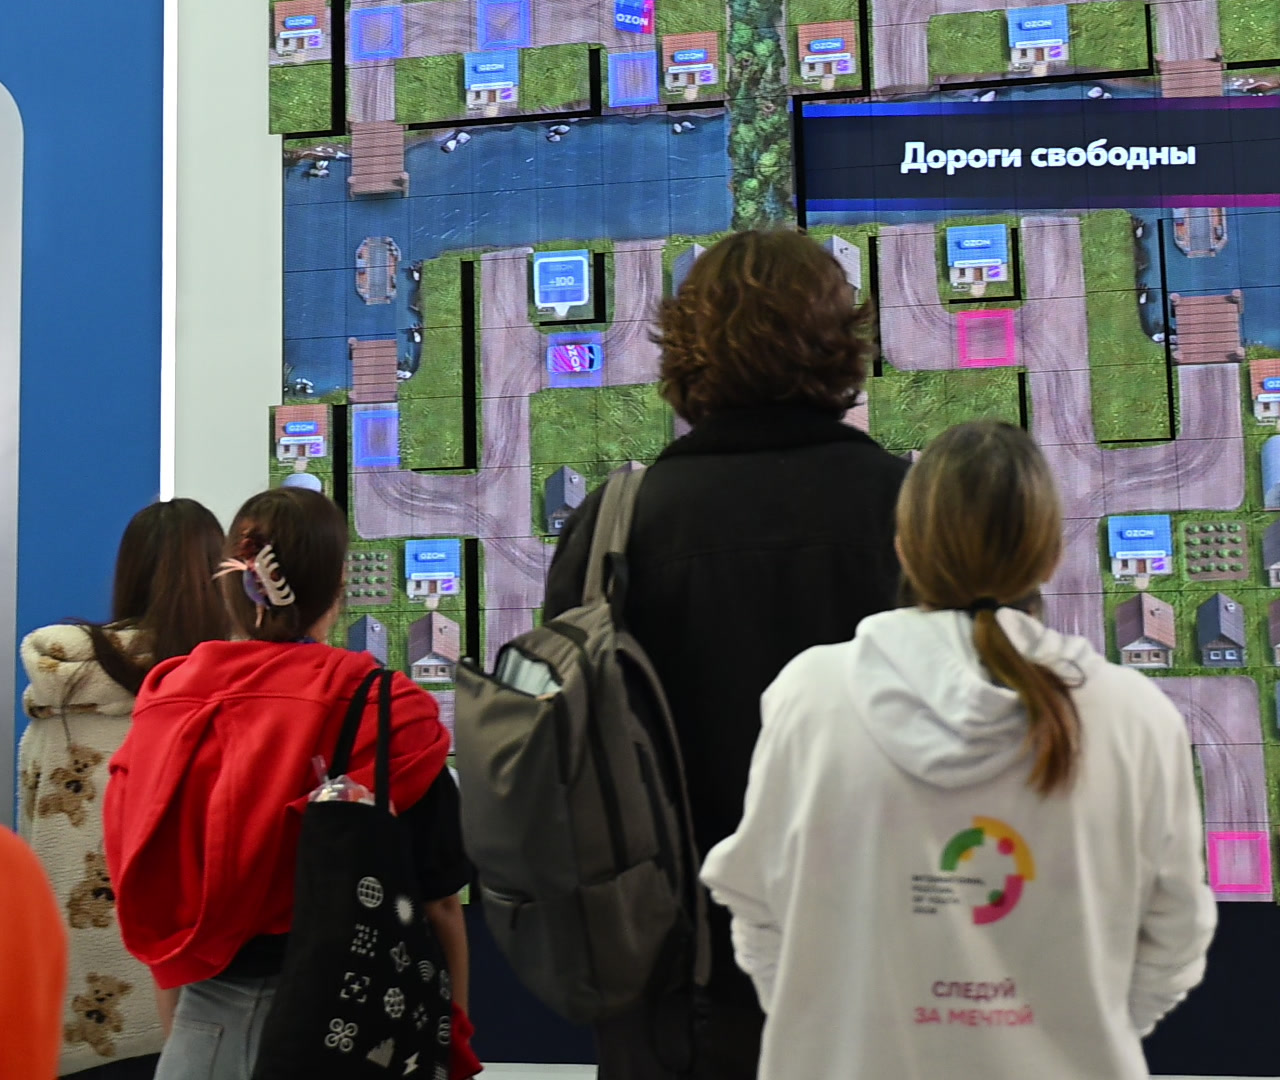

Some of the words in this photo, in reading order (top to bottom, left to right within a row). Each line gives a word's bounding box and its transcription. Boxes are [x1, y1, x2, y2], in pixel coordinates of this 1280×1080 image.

[616, 13, 648, 26] OZON
[900, 141, 1022, 175] Дороги
[1030, 139, 1196, 171] свободны
[962, 239, 991, 247] OZON
[1125, 529, 1154, 537] OZON
[931, 978, 1016, 1002] СЛЕДУЙ
[913, 1006, 941, 1025] ЗА
[948, 1004, 1035, 1027] МЕЧТОЙ
